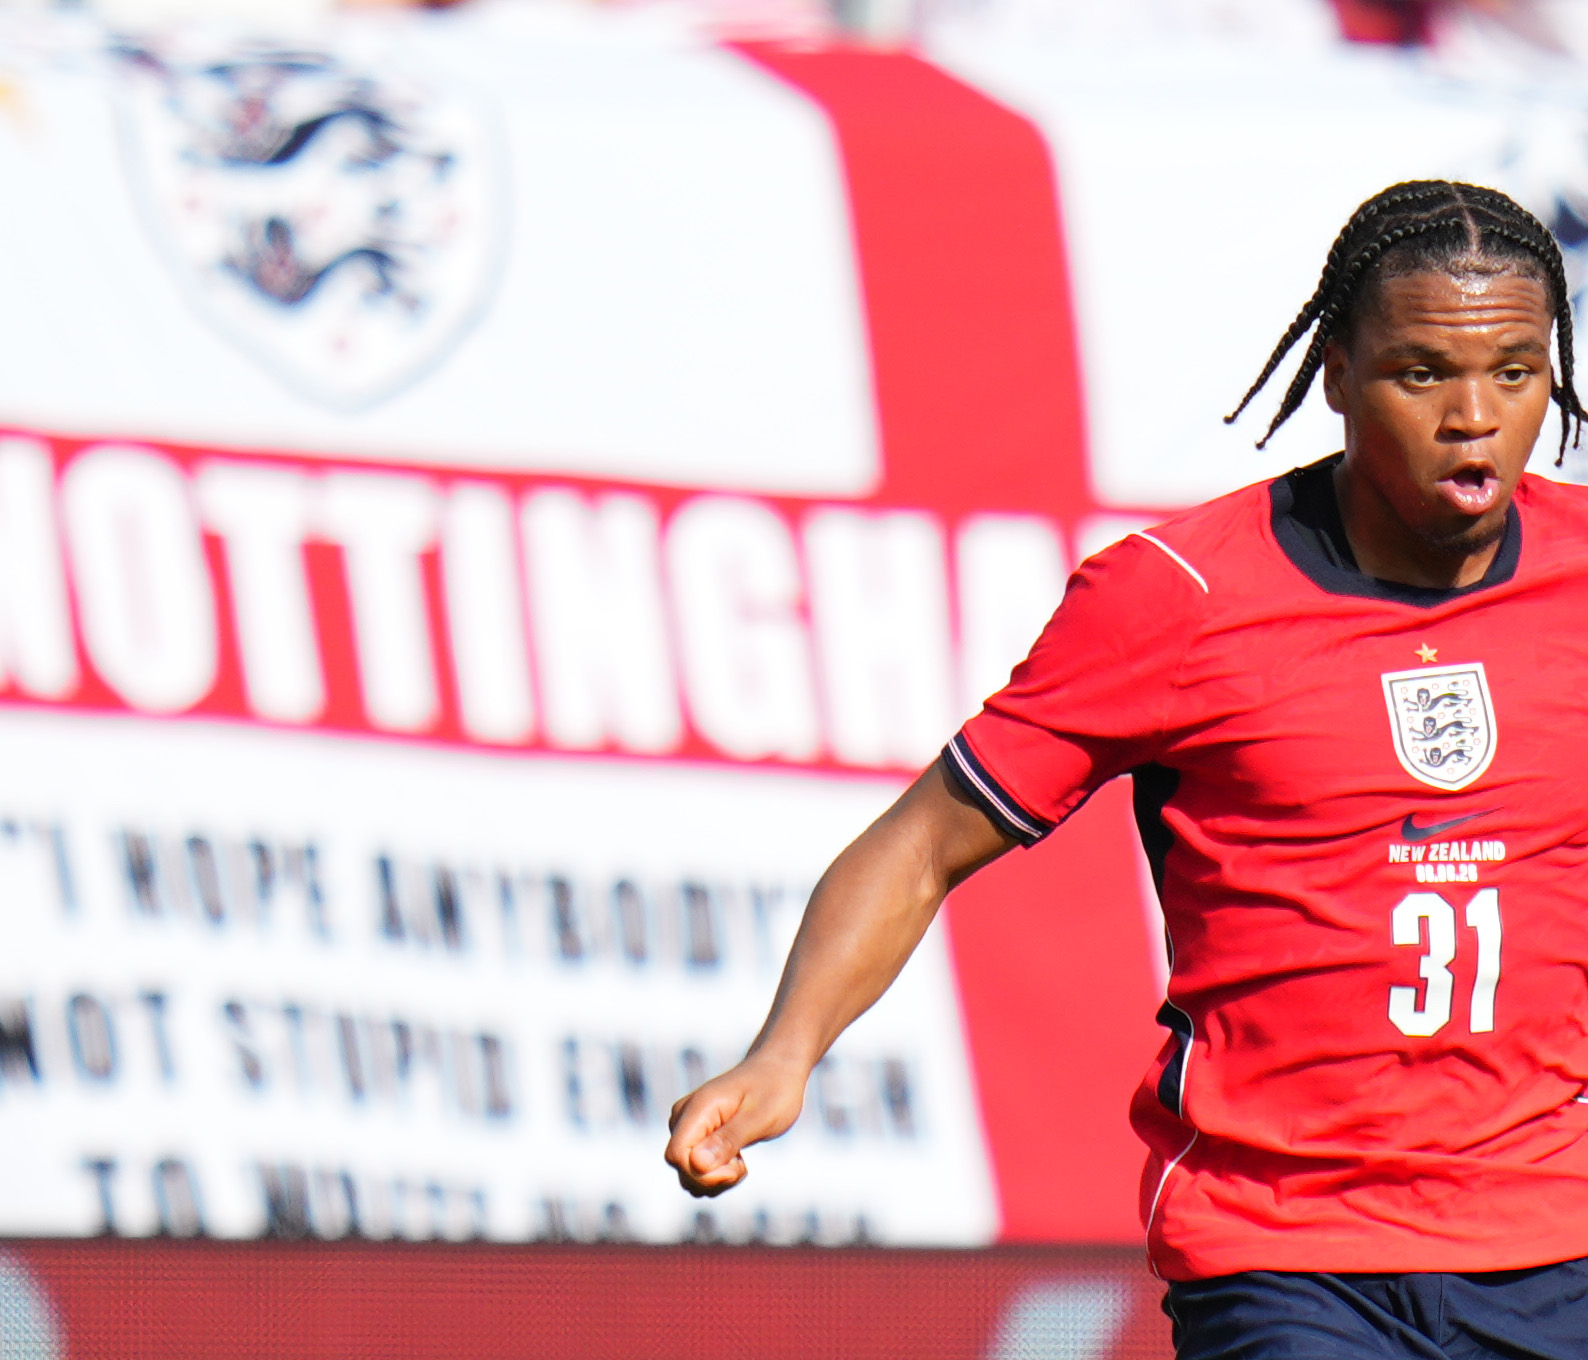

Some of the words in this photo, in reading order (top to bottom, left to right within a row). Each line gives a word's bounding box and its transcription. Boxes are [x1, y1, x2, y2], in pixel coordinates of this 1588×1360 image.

[0, 437, 1165, 772] OTTINGHA
[1388, 844, 1427, 863] NEW
[1428, 841, 1506, 862] ZEALAND
[1388, 888, 1502, 1038] 31
